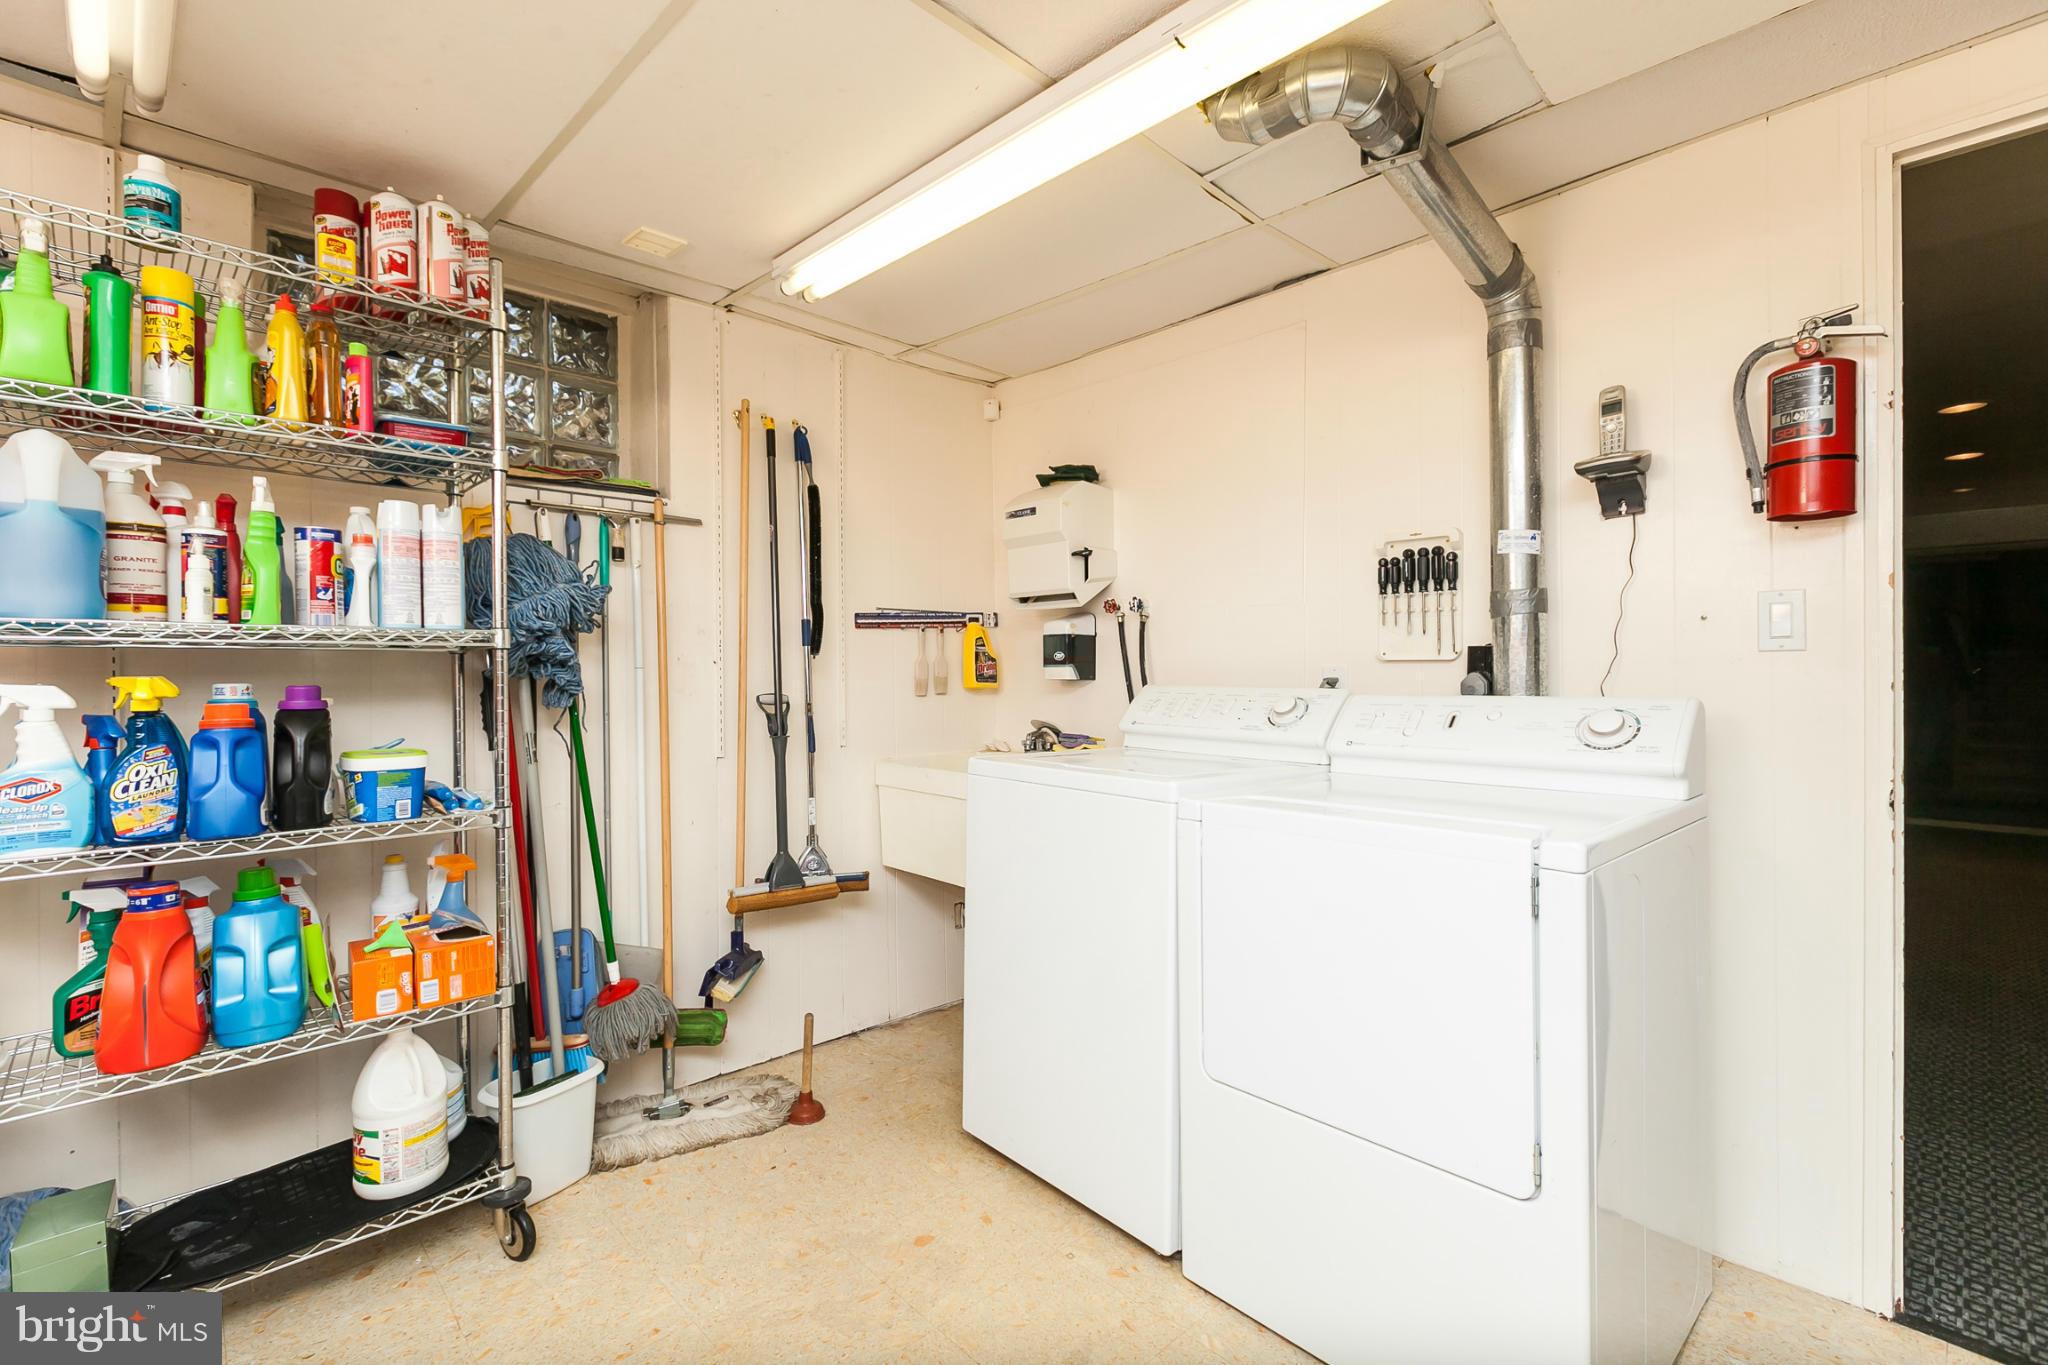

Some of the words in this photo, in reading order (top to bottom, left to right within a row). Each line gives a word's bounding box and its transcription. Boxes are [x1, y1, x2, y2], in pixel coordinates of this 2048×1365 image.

[375, 210, 411, 224] Power
[378, 219, 413, 232] house
[145, 301, 176, 315] ORTHO
[113, 555, 158, 563] GRANITE
[128, 763, 165, 783] OXI
[0, 781, 56, 800] CLOROX
[113, 771, 176, 800] CLEAN
[131, 786, 171, 802] LAUNDRY
